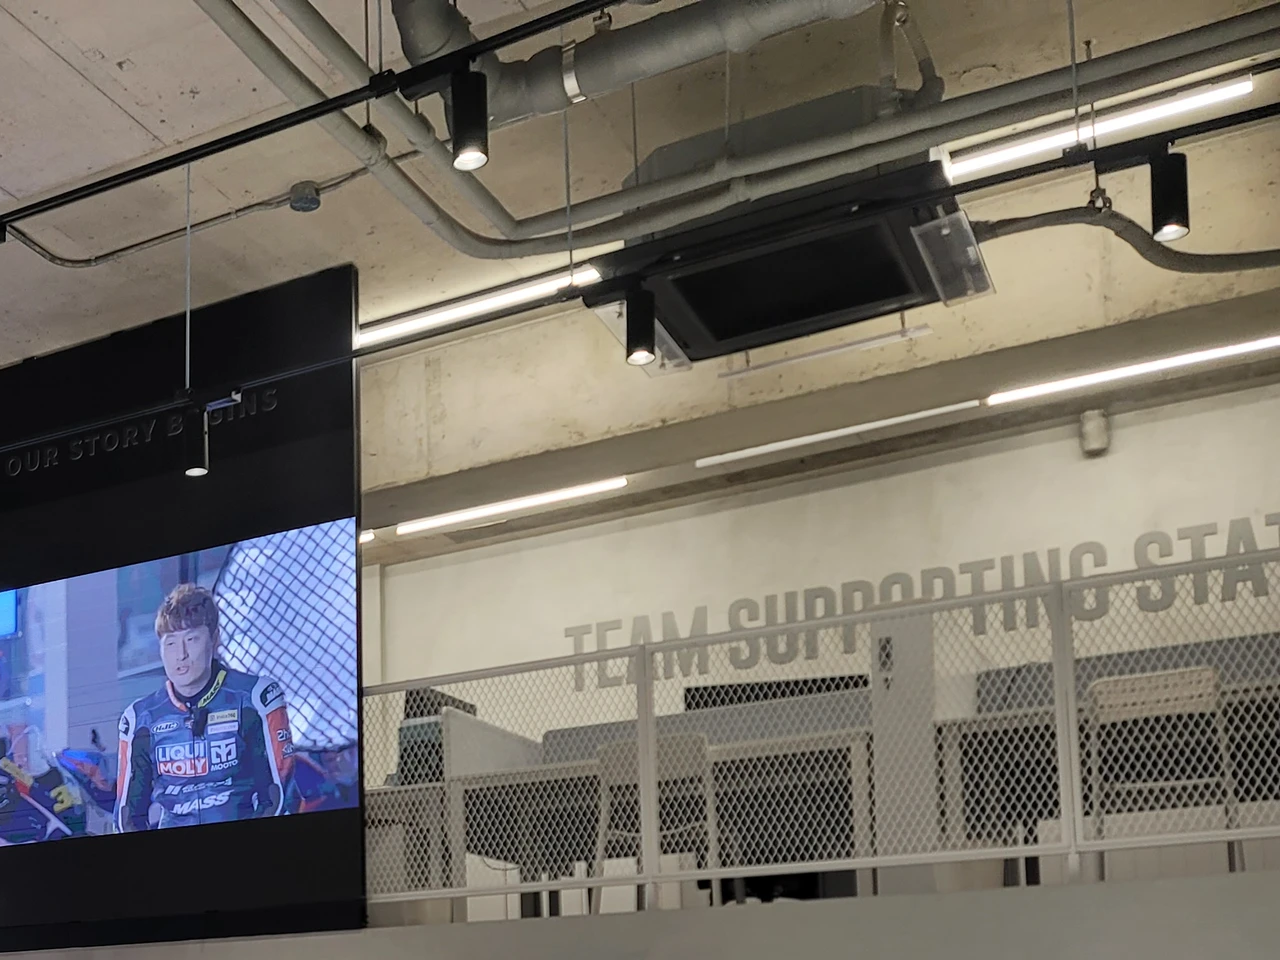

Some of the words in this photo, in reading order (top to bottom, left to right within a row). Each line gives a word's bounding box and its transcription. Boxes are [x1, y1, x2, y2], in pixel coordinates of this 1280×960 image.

[6, 447, 59, 477] OUR
[69, 419, 158, 461] STORY
[167, 389, 278, 437] BGINS
[564, 605, 710, 692] TEAM
[158, 743, 205, 762] LIQUI
[160, 758, 207, 776] MOLY
[210, 760, 239, 772] MOOTO
[170, 789, 235, 815] MASS
